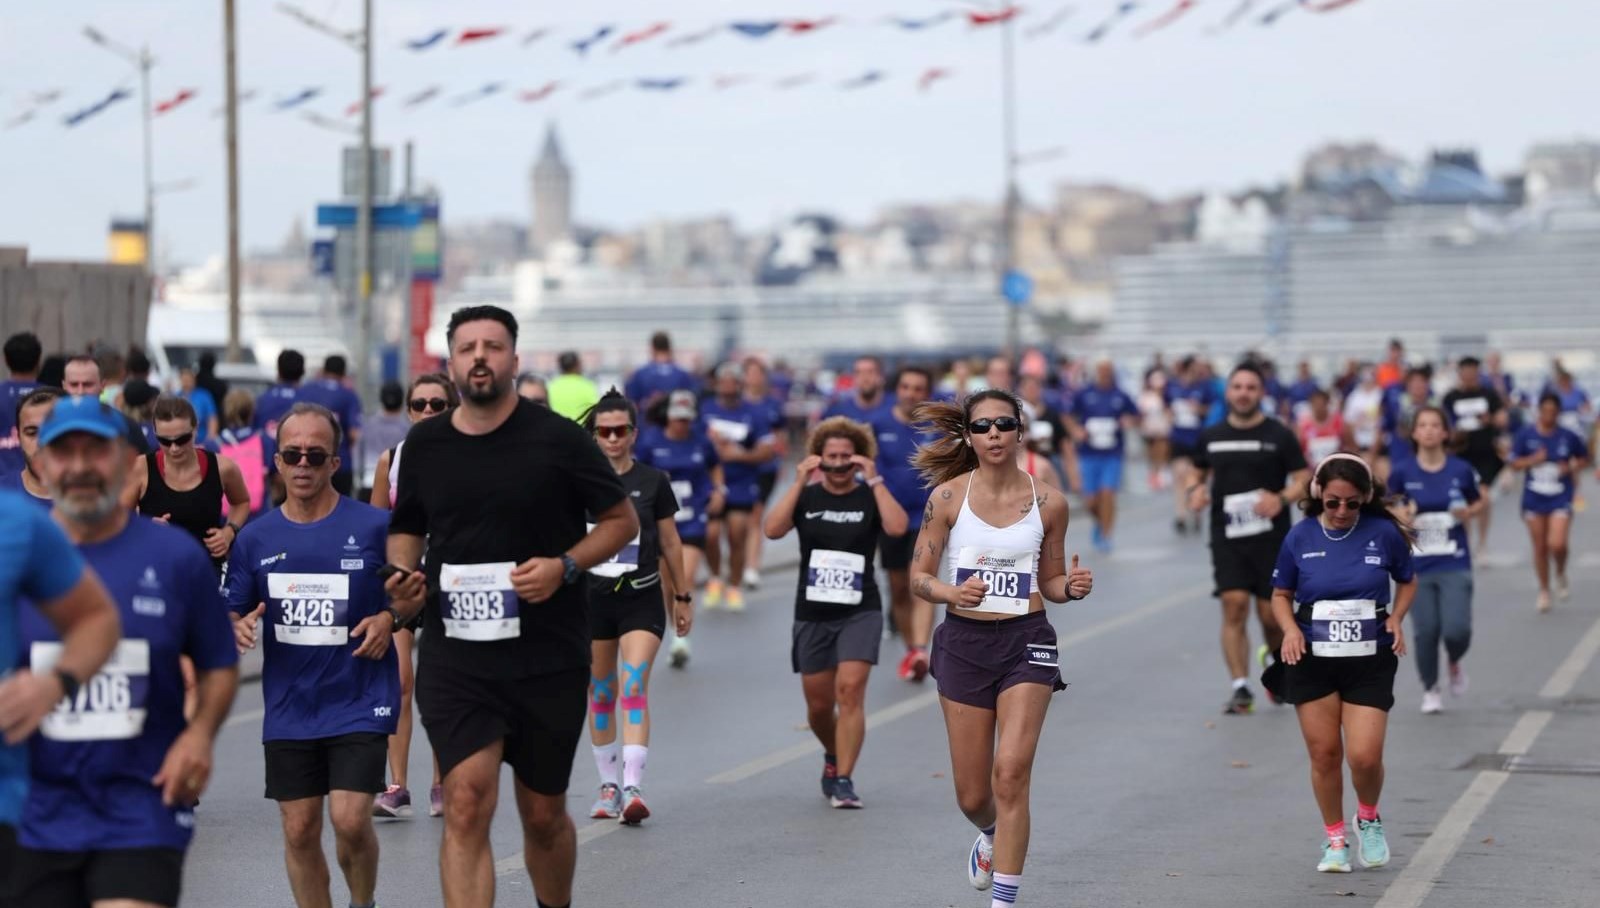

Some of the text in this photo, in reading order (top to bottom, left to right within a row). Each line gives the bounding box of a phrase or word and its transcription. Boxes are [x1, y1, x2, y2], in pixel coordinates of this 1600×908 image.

[815, 568, 855, 590] 2032
[281, 599, 334, 625] 3426
[448, 591, 504, 620] 3993
[1328, 620, 1362, 642] 963
[1031, 650, 1051, 659] 1803
[373, 706, 392, 717] 10K
